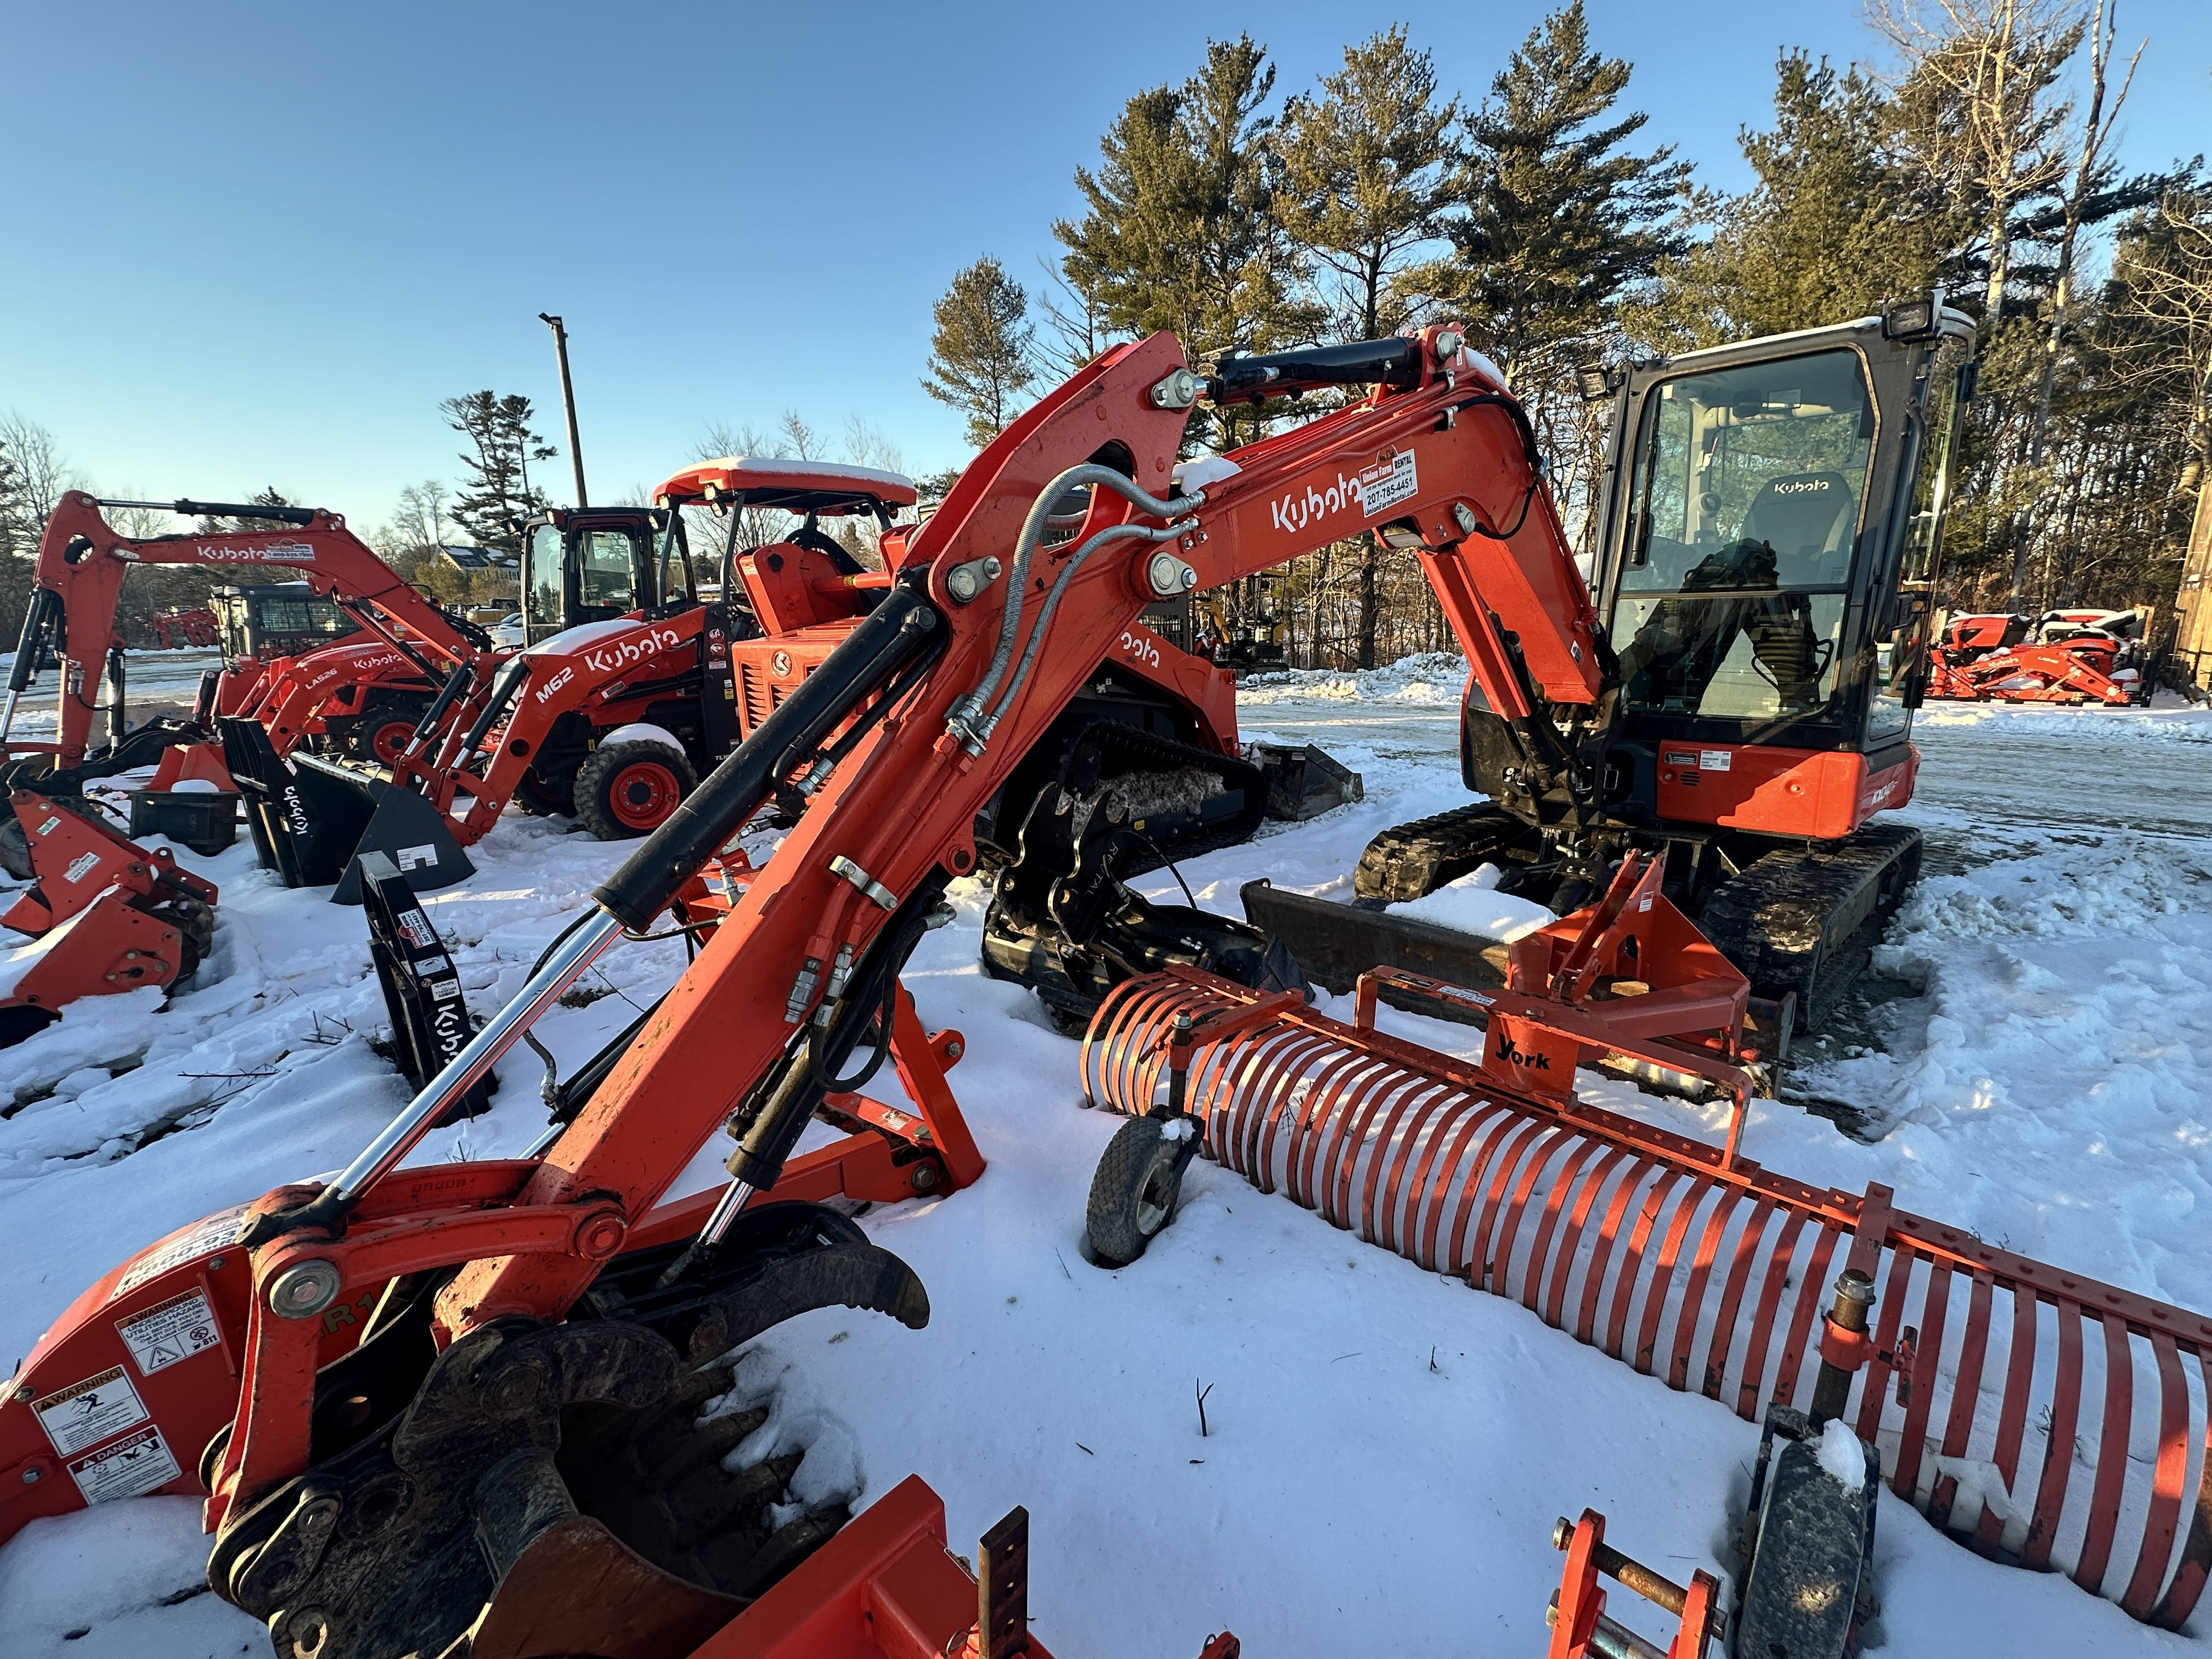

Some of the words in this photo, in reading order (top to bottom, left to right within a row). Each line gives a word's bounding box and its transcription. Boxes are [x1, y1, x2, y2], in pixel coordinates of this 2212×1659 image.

[1362, 470, 1378, 483] Union
[1379, 465, 1392, 477] Farm
[1394, 455, 1412, 470] RENTAL
[1367, 476, 1413, 505] 207-785-4451
[1774, 479, 1829, 494] Kubota
[1271, 472, 1362, 533] Kubota
[197, 546, 268, 560] Kubota
[353, 653, 403, 669] Kubota
[584, 629, 680, 672] Kubota
[305, 668, 338, 690] LA526
[535, 667, 574, 703] M62
[283, 786, 309, 835] Kubota
[435, 1003, 464, 1064] Kubo
[120, 1229, 236, 1286] 1-800-93
[126, 1318, 167, 1339] UTILITIES
[168, 1301, 205, 1320] HAZARD
[127, 1298, 199, 1332] UNDERGROUND
[136, 1293, 193, 1320] WARNING
[202, 1334, 218, 1346] 811
[52, 1369, 121, 1403] WARNING
[96, 1433, 148, 1460] DANGER
